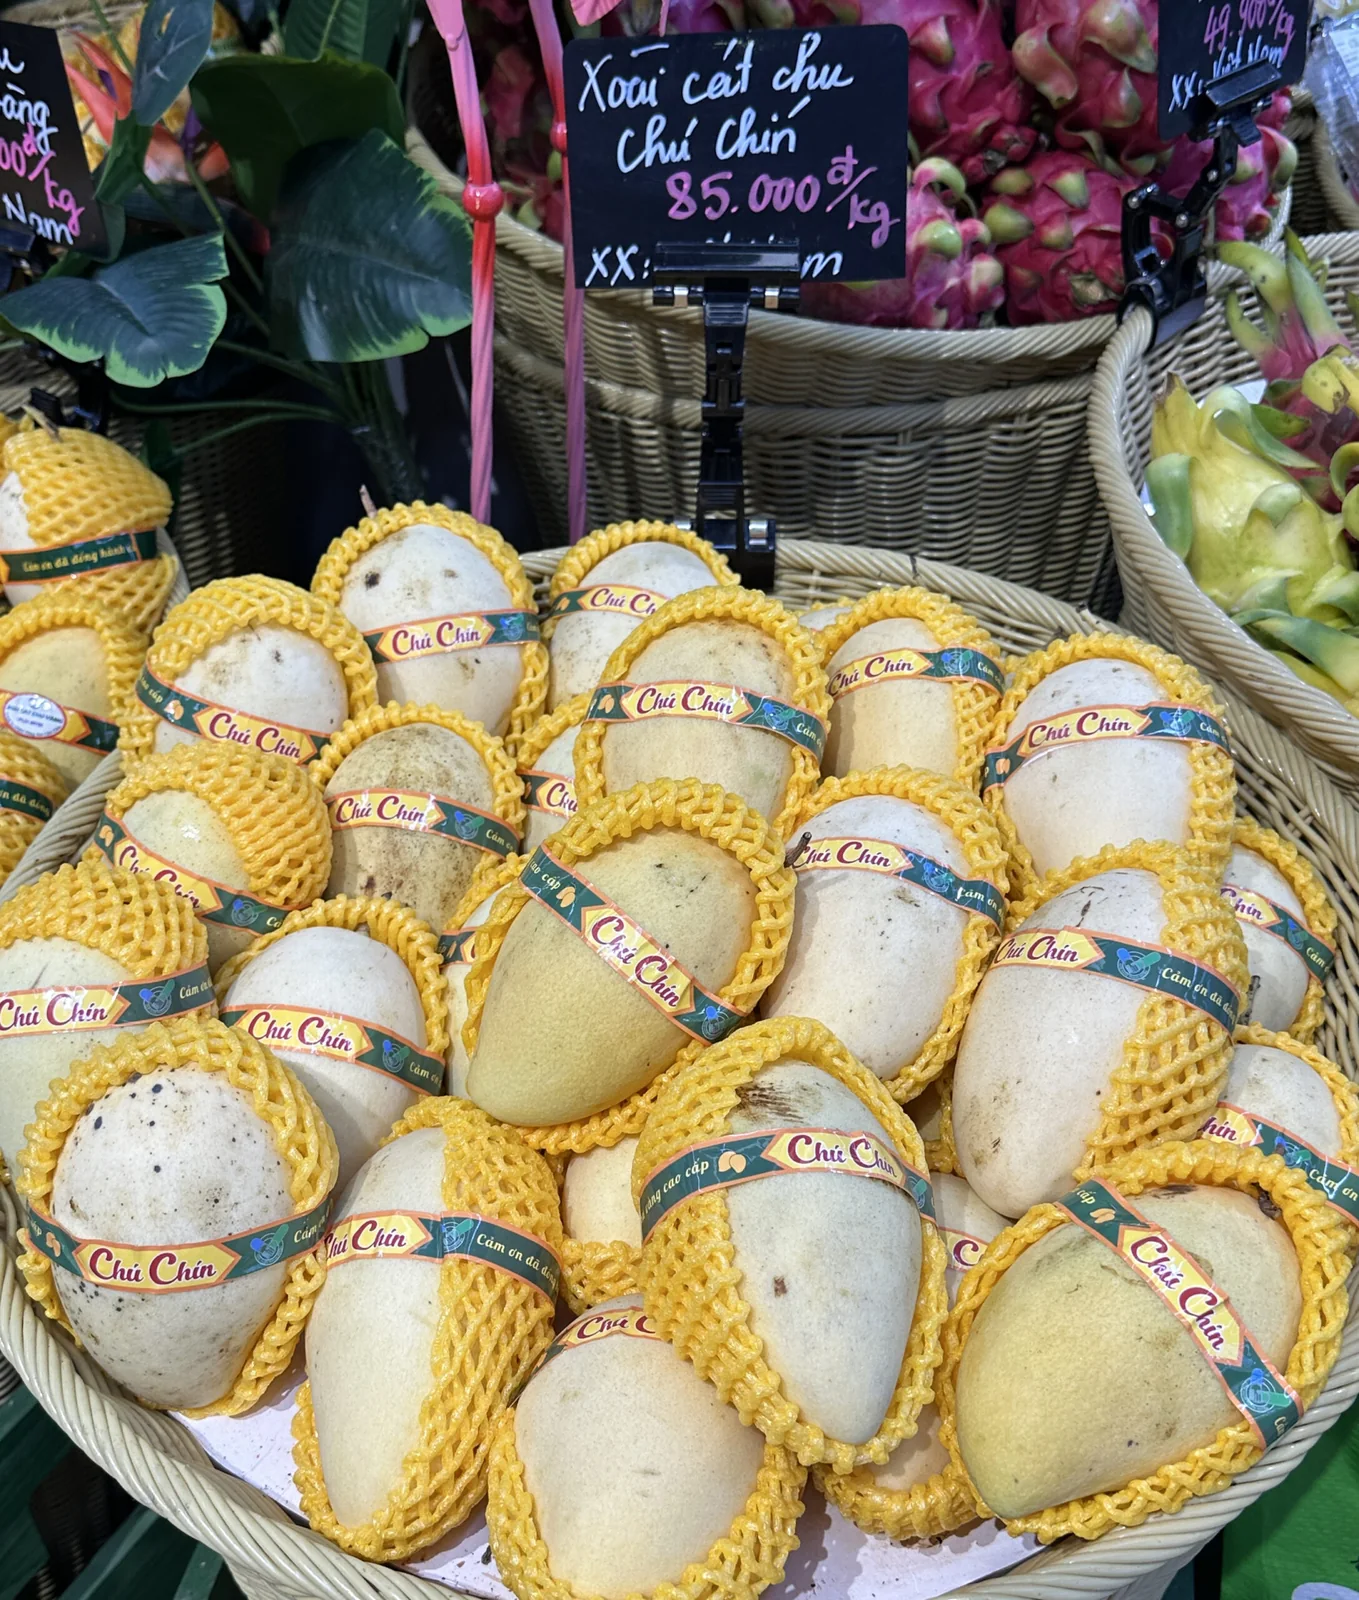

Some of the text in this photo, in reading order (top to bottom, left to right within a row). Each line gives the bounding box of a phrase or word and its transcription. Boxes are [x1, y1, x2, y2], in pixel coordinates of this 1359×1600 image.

[682, 37, 755, 104] cát
[0, 82, 59, 156] àng
[616, 95, 811, 173] Chú Chín
[590, 588, 656, 615] Chú Ch
[392, 621, 481, 656] Chú Chín
[828, 656, 914, 696] Chú Chín
[636, 686, 733, 715] Chú Chín
[209, 712, 301, 759] Chú Chín
[1028, 711, 1132, 748] Chú Chín
[336, 795, 424, 824] Chú Chín
[836, 841, 891, 868] Chín
[541, 872, 561, 891] cấp
[591, 915, 680, 1007] Chú Chín
[994, 935, 1079, 964] Chú Chín
[1161, 967, 1192, 988] Cảm
[1193, 982, 1208, 998] ơn
[1209, 991, 1224, 1007] đã
[0, 993, 108, 1031] Chú Chín
[247, 1011, 353, 1052] Chú Chín
[1199, 1117, 1237, 1141] hín
[787, 1134, 847, 1164] Chú
[663, 1173, 682, 1194] cao
[685, 1157, 709, 1178] cấp
[351, 1219, 407, 1251] Chín
[476, 1232, 505, 1254] Cảm
[508, 1248, 523, 1262] ơn
[525, 1255, 540, 1271] đã
[88, 1247, 217, 1285] Chú Chín
[1131, 1236, 1225, 1351] Chú Chín
